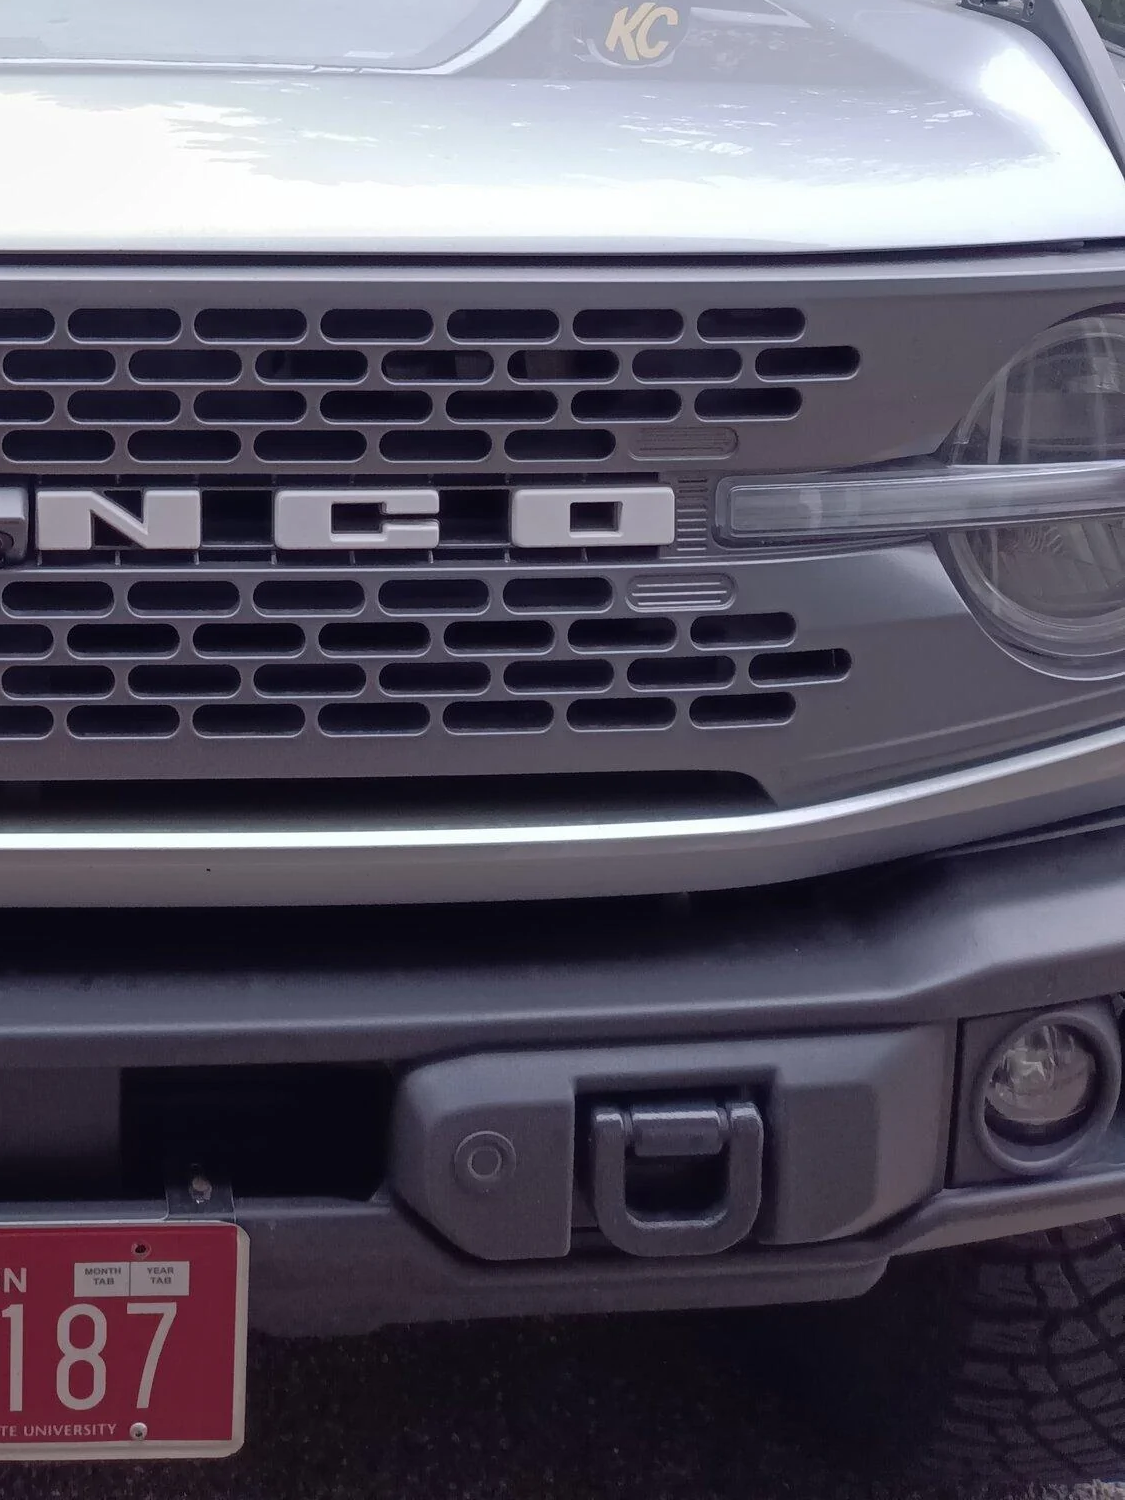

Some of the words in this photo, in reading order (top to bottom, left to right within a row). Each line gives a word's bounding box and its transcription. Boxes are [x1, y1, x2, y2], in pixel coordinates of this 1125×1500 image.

[84, 1267, 122, 1275] MONTH
[147, 1267, 175, 1275] YEAR
[93, 1277, 115, 1286] TAB
[150, 1277, 173, 1285] TAB
[23, 1422, 117, 1437] UNIVERSITY
